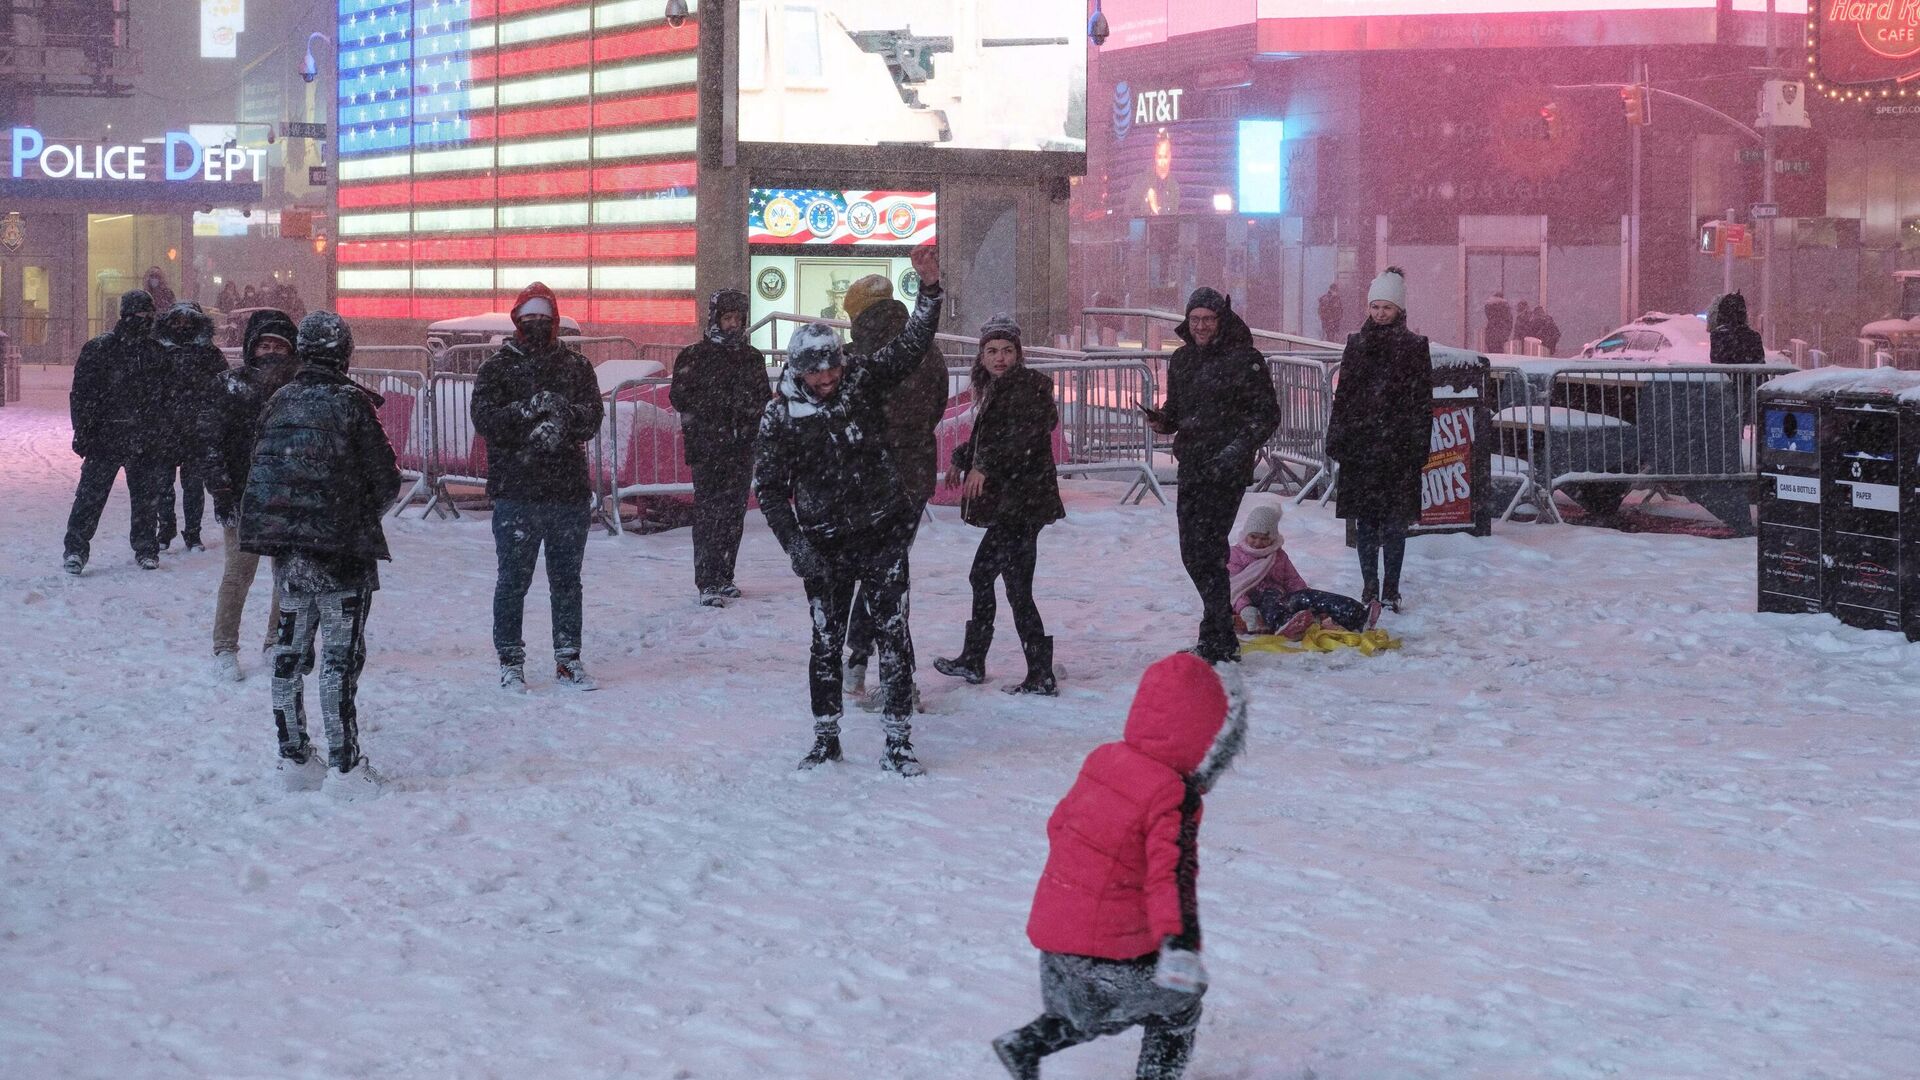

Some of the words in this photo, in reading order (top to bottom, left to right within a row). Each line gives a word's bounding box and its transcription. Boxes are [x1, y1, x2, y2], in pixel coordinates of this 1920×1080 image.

[1829, 0, 1896, 21] Hard
[1877, 28, 1915, 41] CAFE
[1135, 89, 1183, 124] AT&T
[1430, 406, 1475, 453] RSEY
[1421, 461, 1470, 511] BOYS
[1780, 483, 1792, 493] CANS
[1793, 485, 1797, 493] &
[1797, 485, 1817, 495] BOTTLES
[1855, 491, 1873, 500] PAPER
